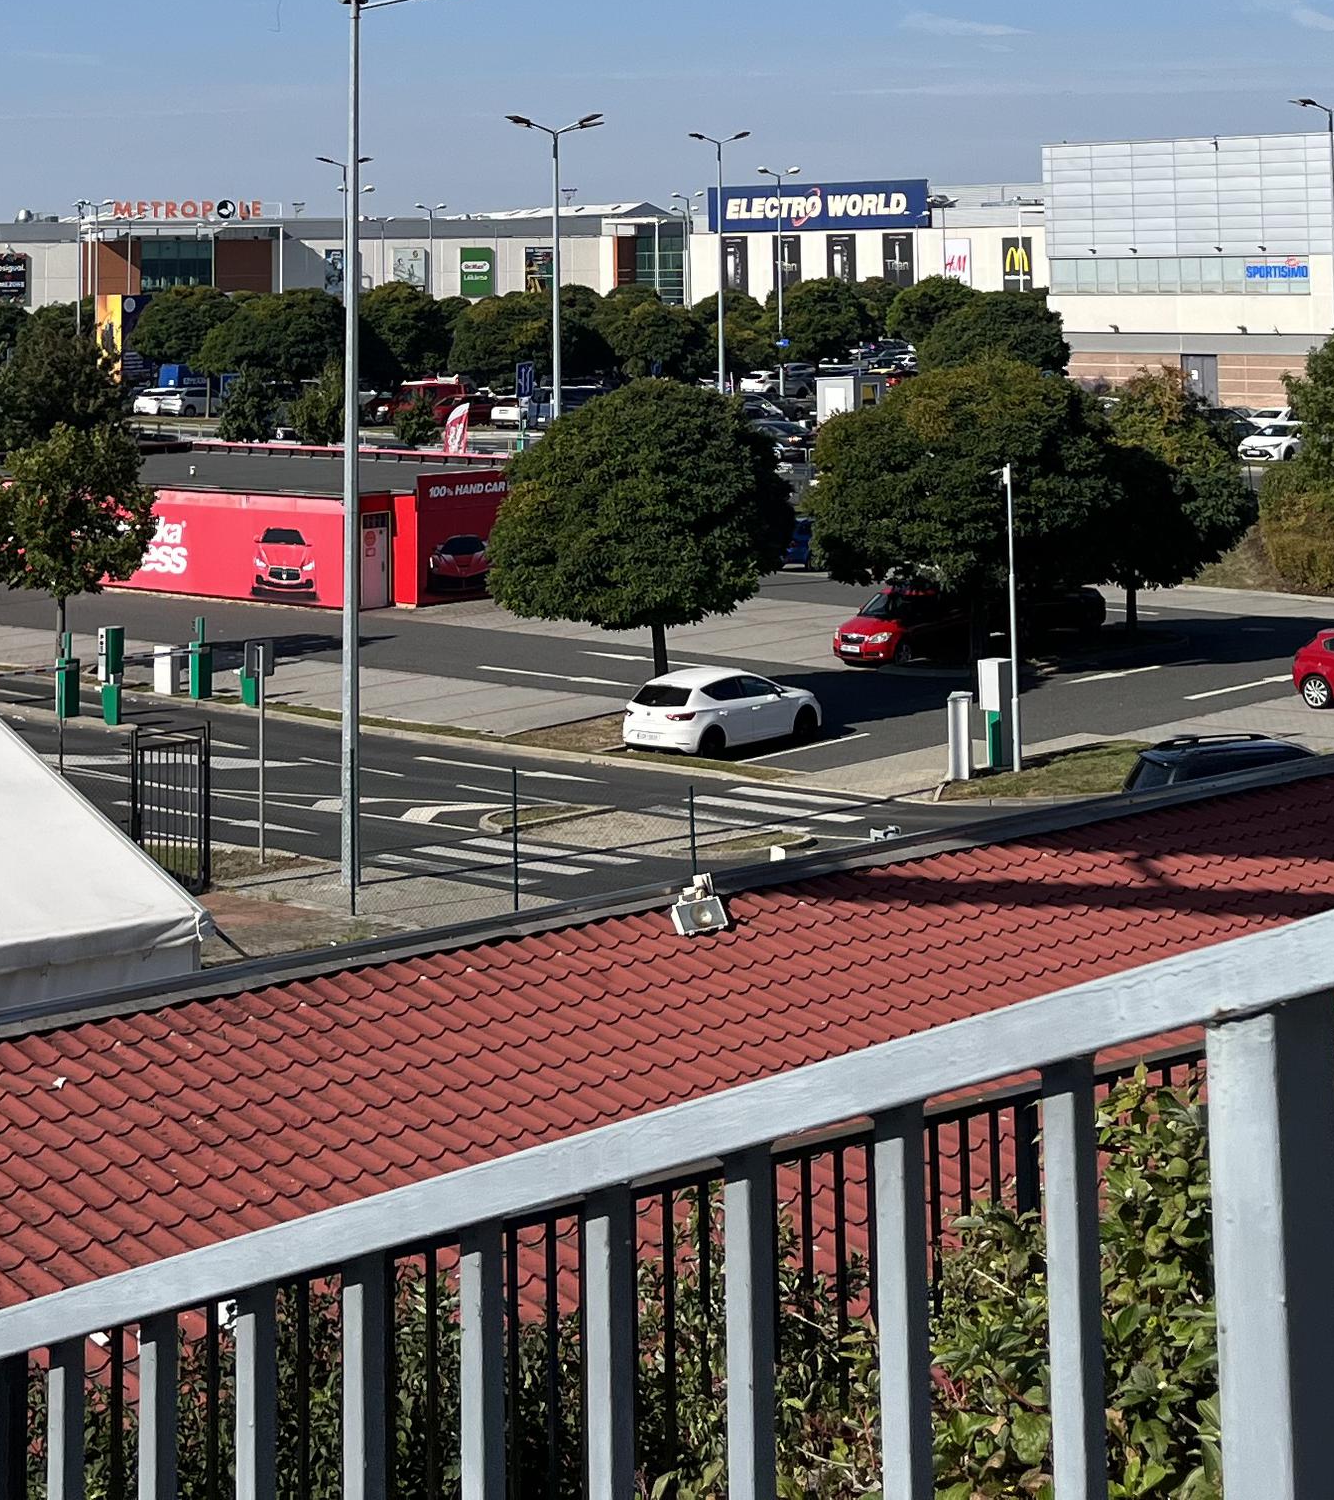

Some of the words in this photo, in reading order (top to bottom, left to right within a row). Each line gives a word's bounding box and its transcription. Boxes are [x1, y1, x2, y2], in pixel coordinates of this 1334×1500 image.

[113, 200, 263, 219] METROPOLE
[725, 194, 822, 220] ELECTRO
[485, 481, 506, 493] CAR
